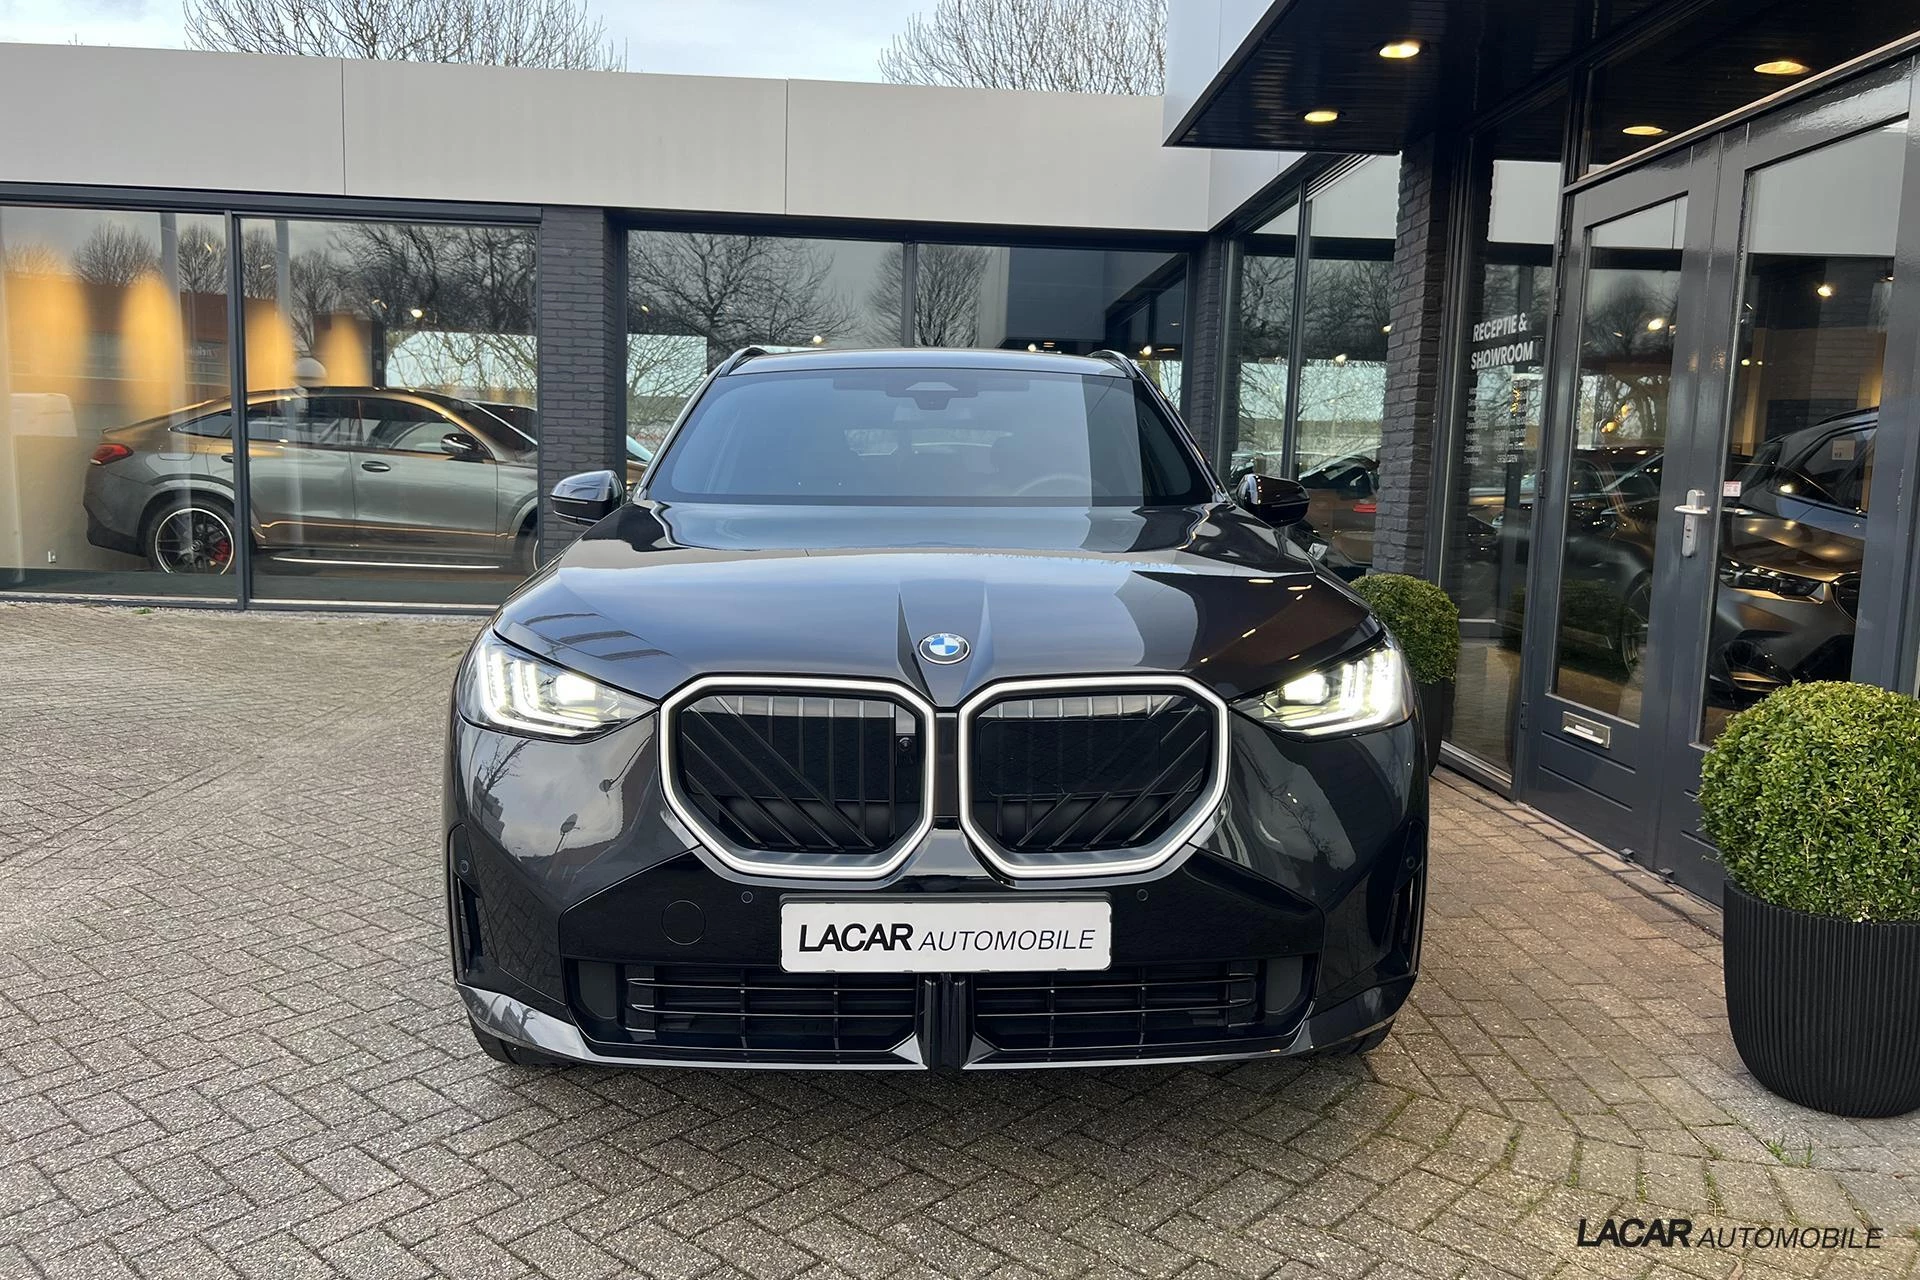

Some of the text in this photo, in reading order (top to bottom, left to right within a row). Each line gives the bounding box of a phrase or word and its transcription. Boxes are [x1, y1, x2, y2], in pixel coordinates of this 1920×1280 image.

[1472, 312, 1528, 342] RECEPTIE &
[1471, 340, 1534, 370] SHOWROOM
[799, 923, 1096, 952] LACAR AUTOMOBILE
